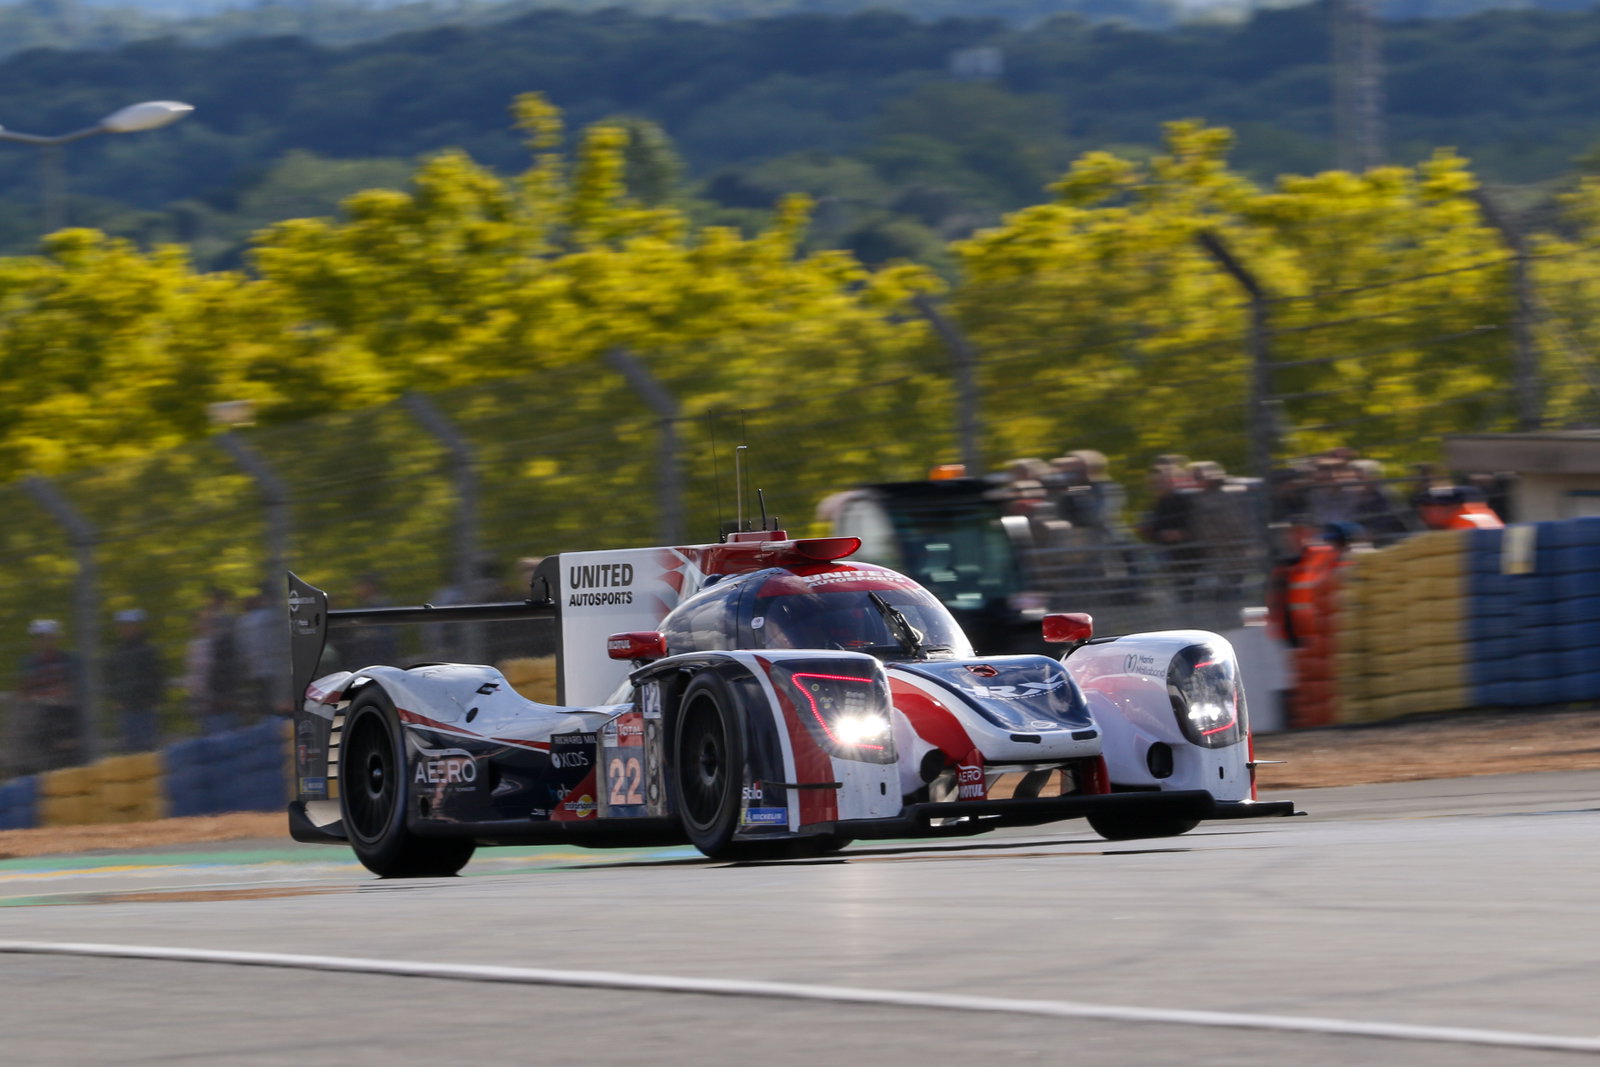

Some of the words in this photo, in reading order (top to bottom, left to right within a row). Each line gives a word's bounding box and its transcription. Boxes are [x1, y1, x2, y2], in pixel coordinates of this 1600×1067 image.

[569, 563, 634, 590] UNITED
[802, 570, 903, 584] UNITED
[569, 591, 633, 607] AUTOSPORTS
[554, 735, 583, 745] RICHARD
[559, 751, 589, 768] XCDS
[414, 759, 477, 784] AERO
[609, 757, 643, 805] 22
[751, 813, 783, 821] MICHELIN
